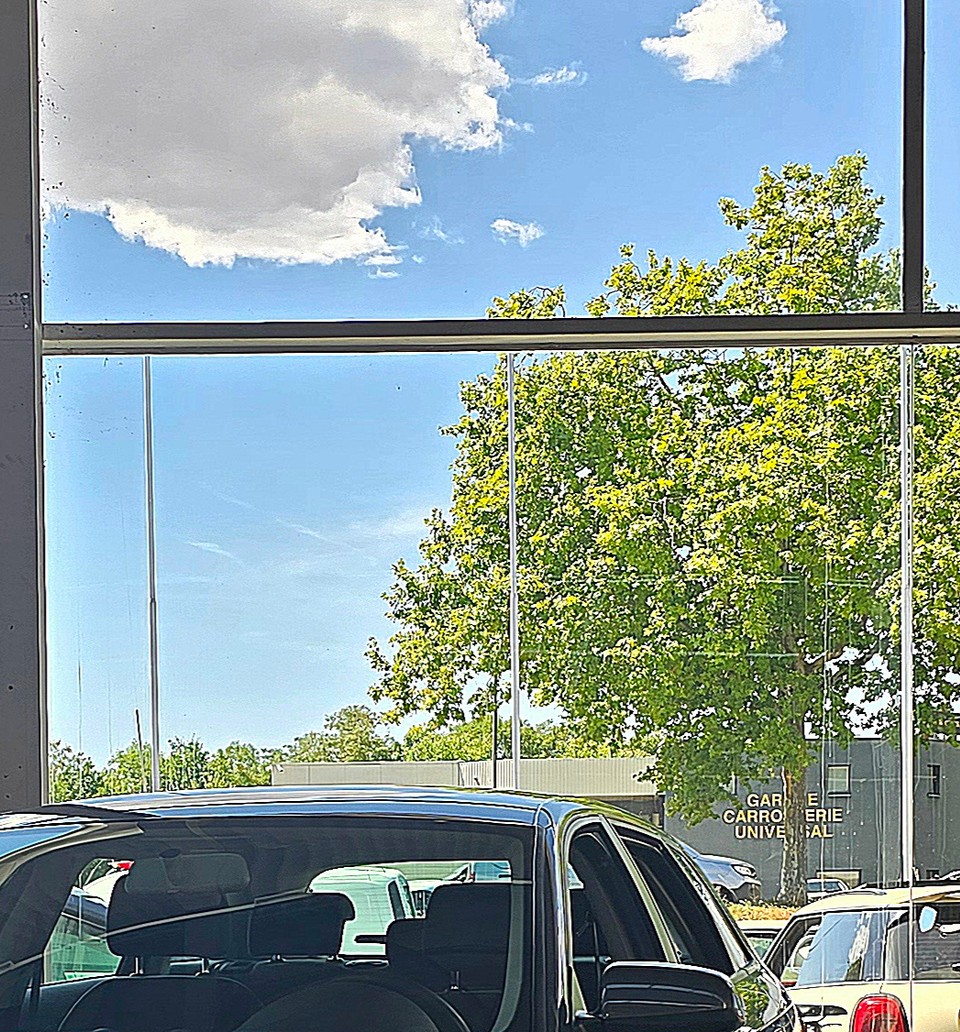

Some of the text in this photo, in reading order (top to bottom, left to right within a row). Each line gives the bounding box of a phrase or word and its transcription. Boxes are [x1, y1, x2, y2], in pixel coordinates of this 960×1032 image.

[747, 793, 818, 807] GARE
[723, 809, 843, 823] CARROERIE
[735, 825, 834, 838] UNIVEAL
